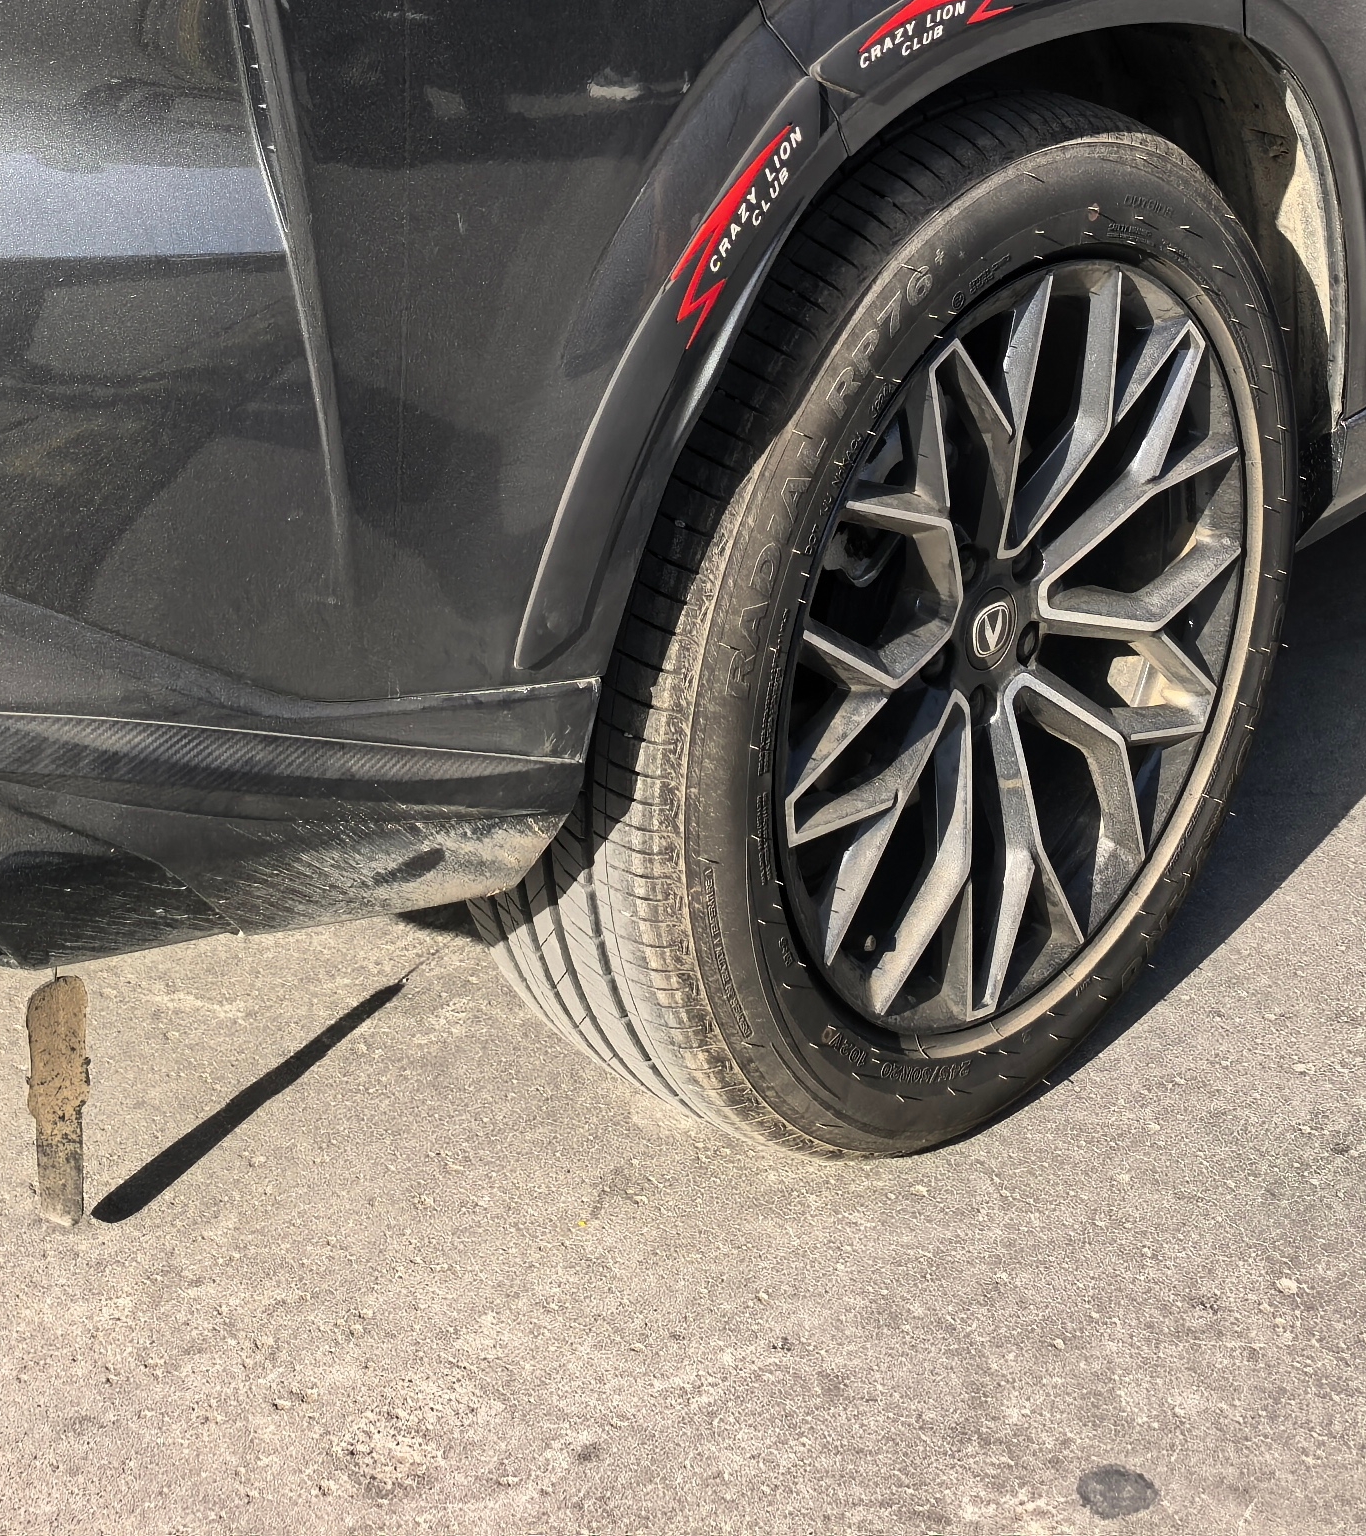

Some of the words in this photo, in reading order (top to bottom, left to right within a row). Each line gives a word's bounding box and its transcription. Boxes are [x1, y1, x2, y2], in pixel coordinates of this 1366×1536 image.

[859, 20, 917, 69] CRAZY
[926, 0, 966, 28] LION
[901, 24, 944, 56] CLUB
[709, 186, 757, 273] CRAZY
[764, 126, 803, 182] LION
[751, 167, 789, 226] CLUB
[725, 436, 827, 699] RADIAL
